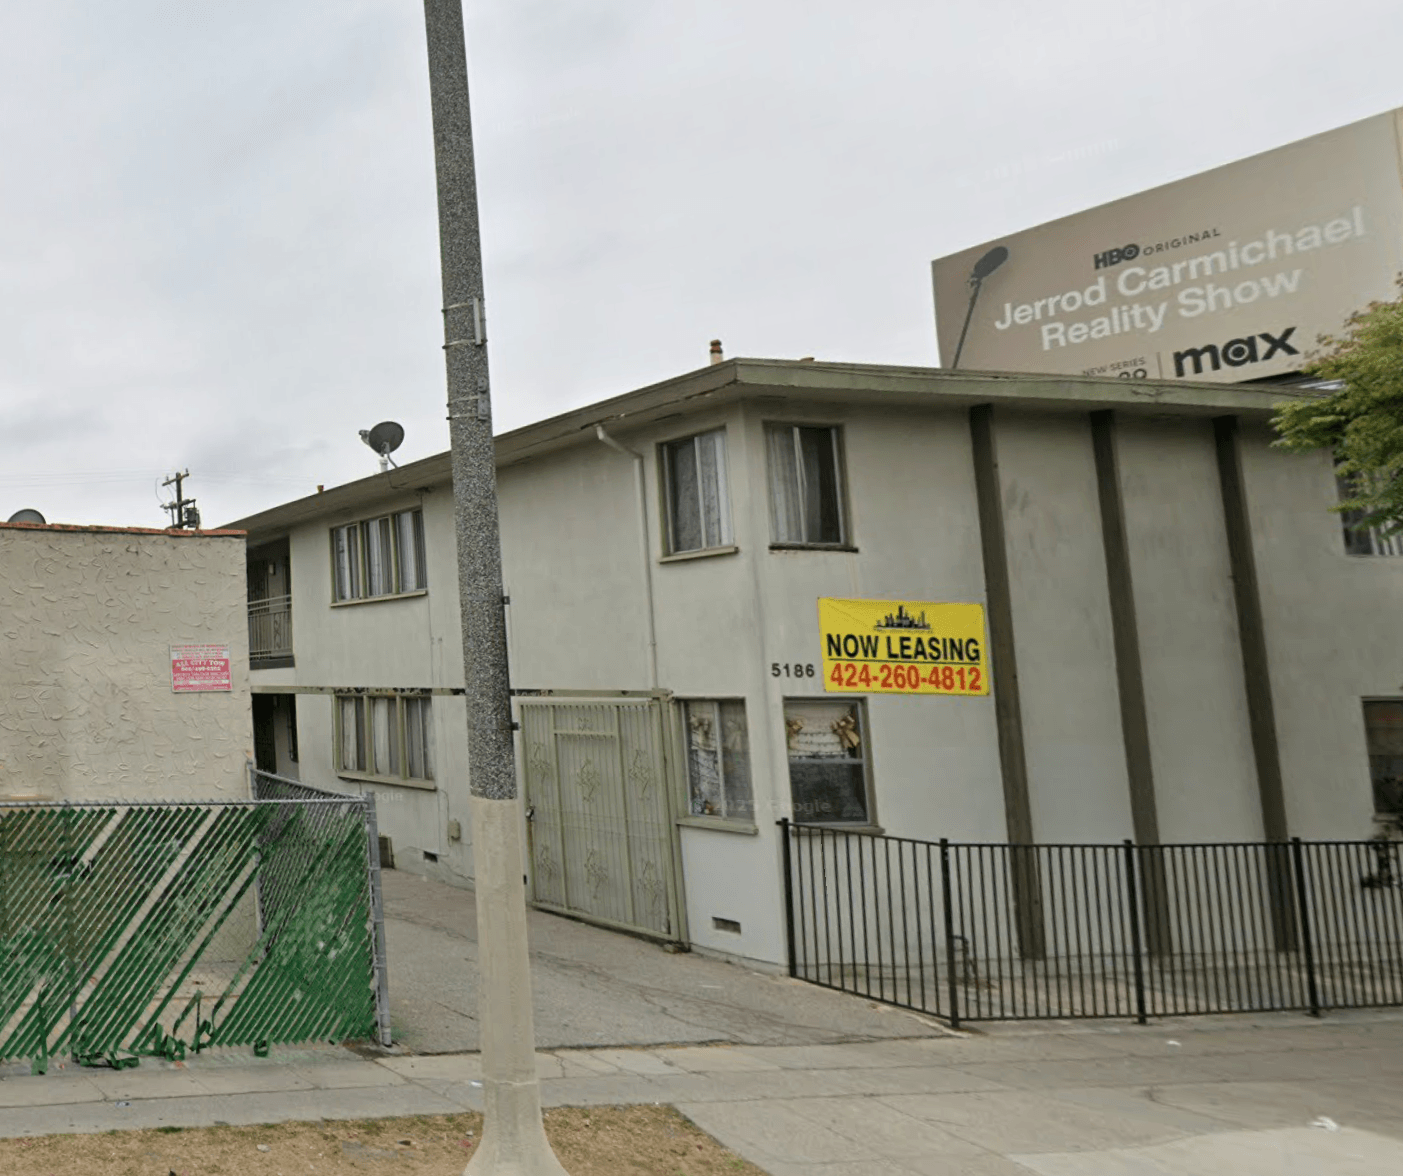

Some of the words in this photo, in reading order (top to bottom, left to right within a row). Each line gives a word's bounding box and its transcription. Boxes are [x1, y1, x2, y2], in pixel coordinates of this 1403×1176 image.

[1093, 243, 1140, 270] HBO
[1143, 228, 1221, 256] ORIGINAL
[994, 276, 1107, 330] Jerrod
[1117, 205, 1365, 297] Carmichael
[1041, 301, 1168, 351] Reality
[1177, 268, 1304, 318] Show
[1110, 357, 1146, 372] SERIES
[1173, 326, 1300, 378] max
[826, 633, 879, 658] NOW
[886, 635, 980, 662] LEASING
[771, 662, 815, 678] 5186
[829, 663, 982, 691] 424-260-4812
